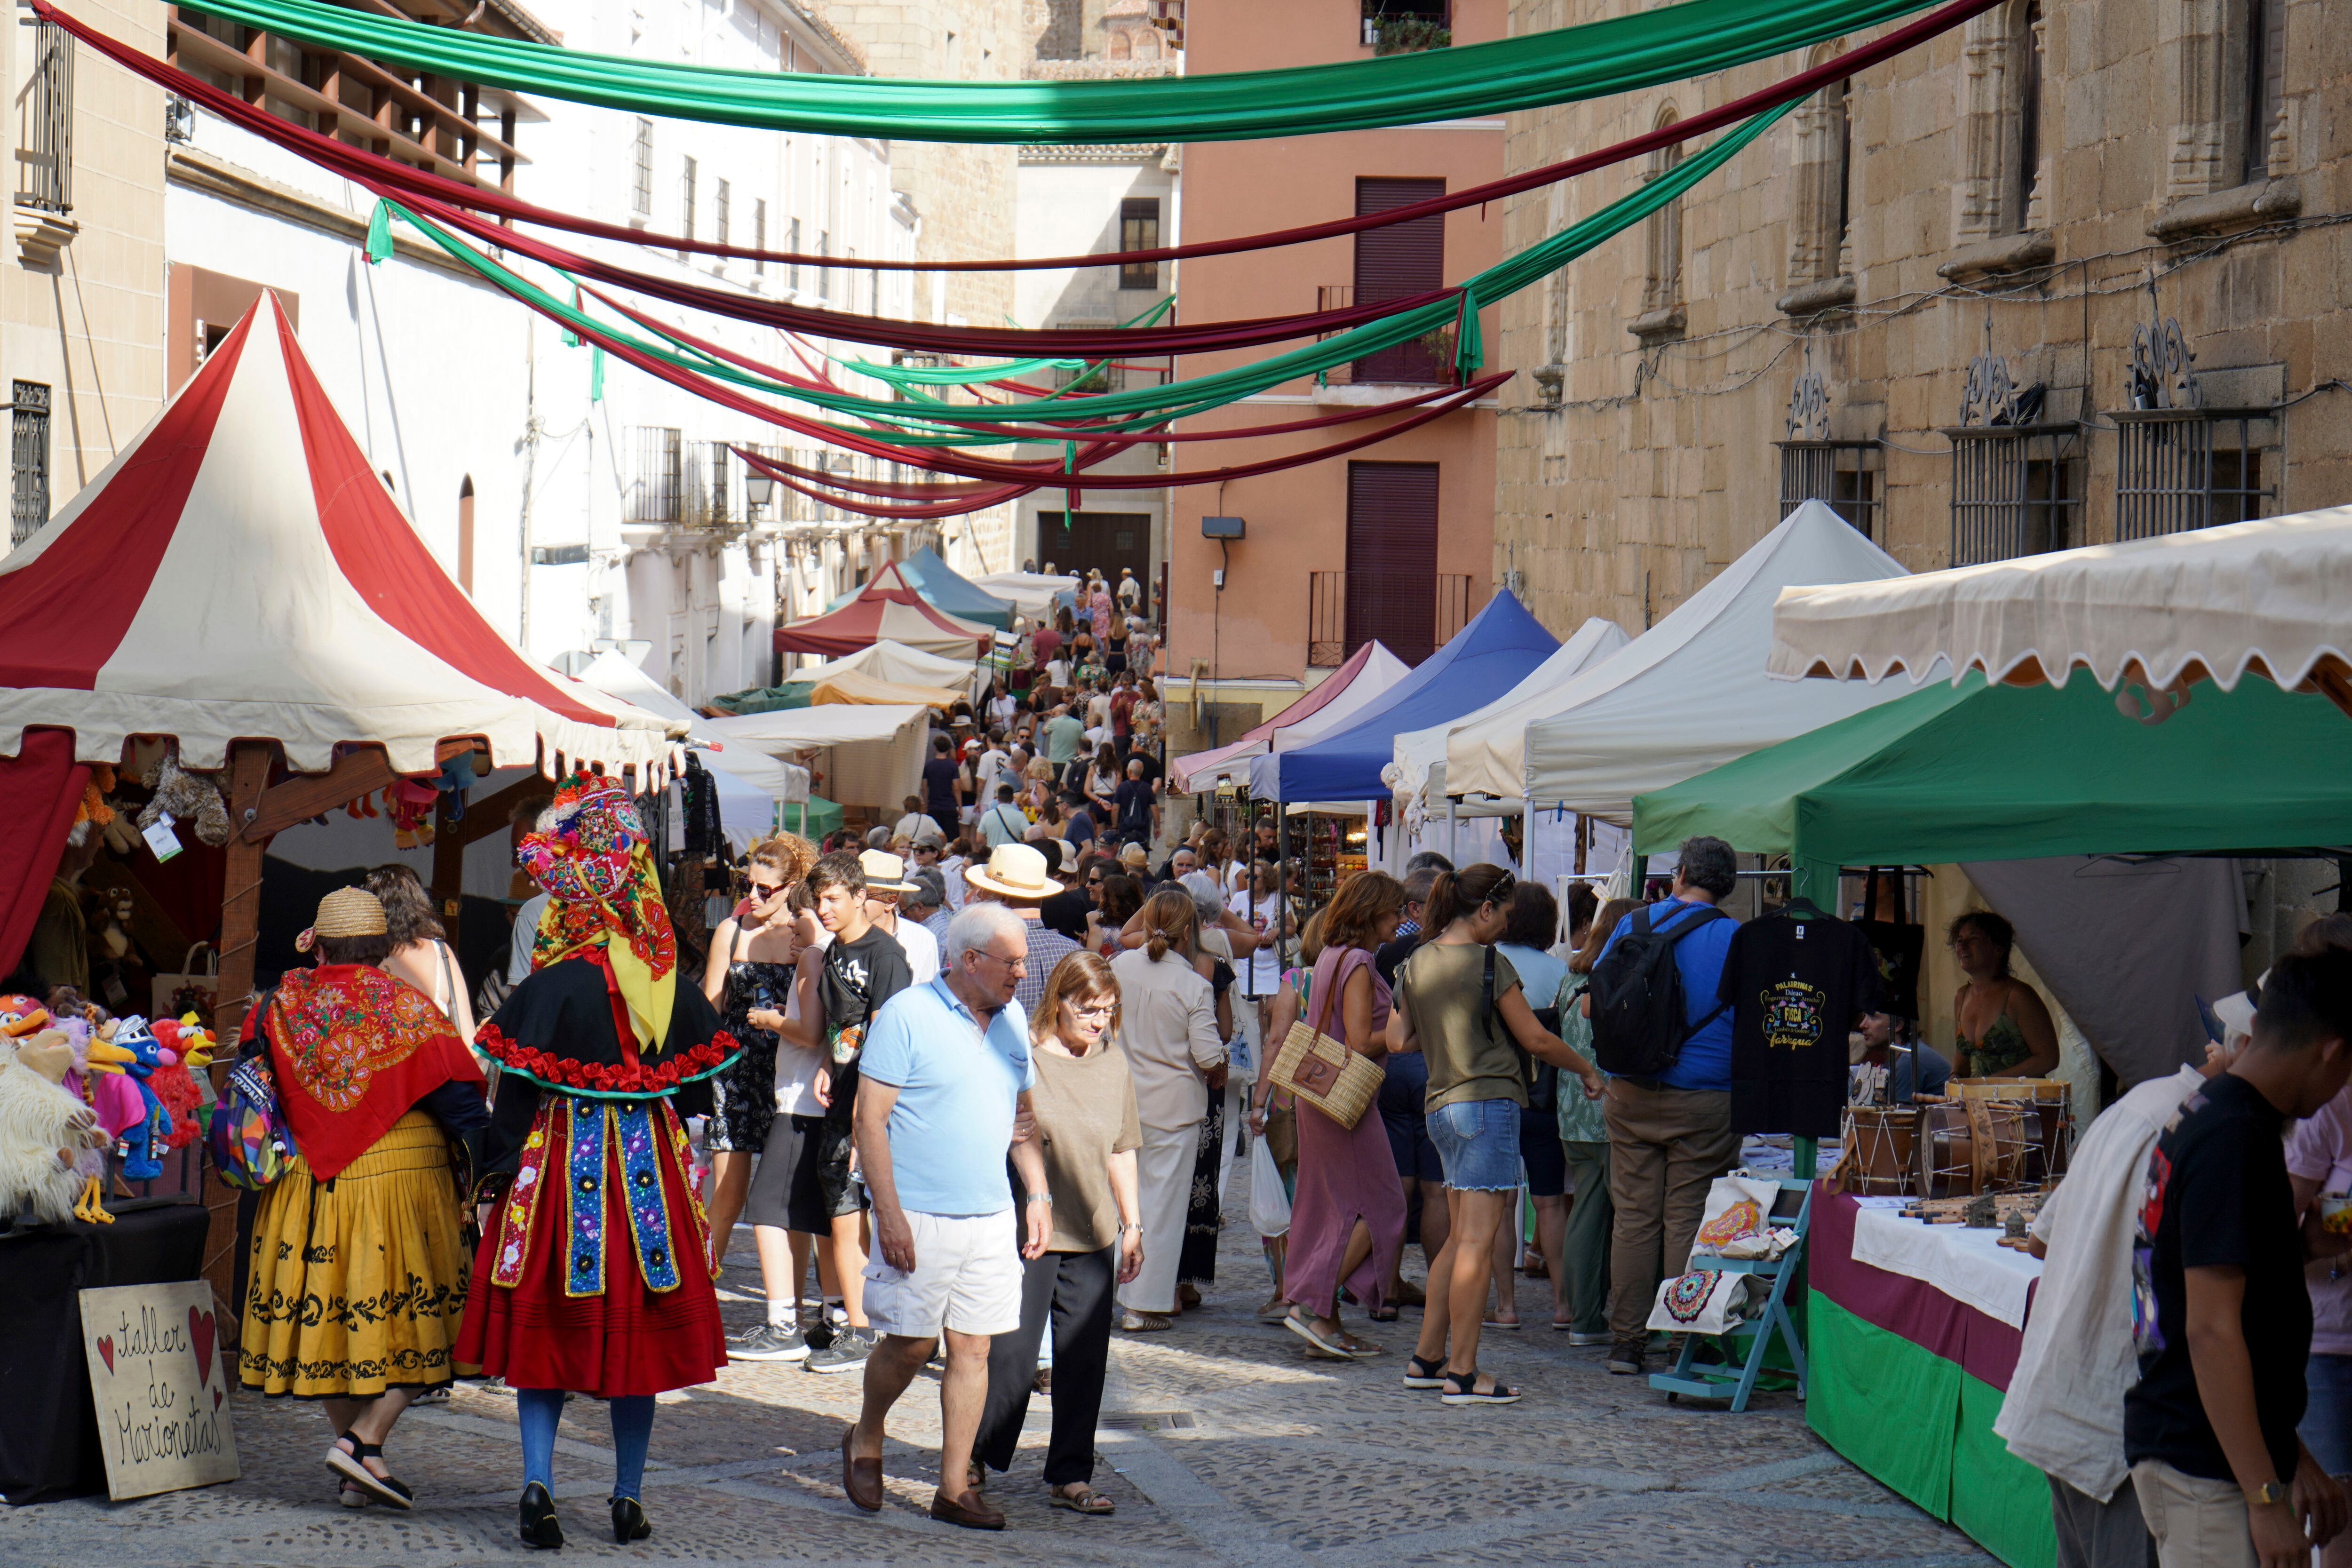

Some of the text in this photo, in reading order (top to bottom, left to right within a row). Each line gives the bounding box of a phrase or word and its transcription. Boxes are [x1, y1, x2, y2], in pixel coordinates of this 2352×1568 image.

[1775, 981, 1813, 992] PALABRINAS
[1785, 1008, 1802, 1022] FUSCA
[1303, 1062, 1327, 1084] P
[119, 1305, 186, 1358] taller
[148, 1359, 175, 1408] de
[115, 1395, 221, 1466] Marionetas
